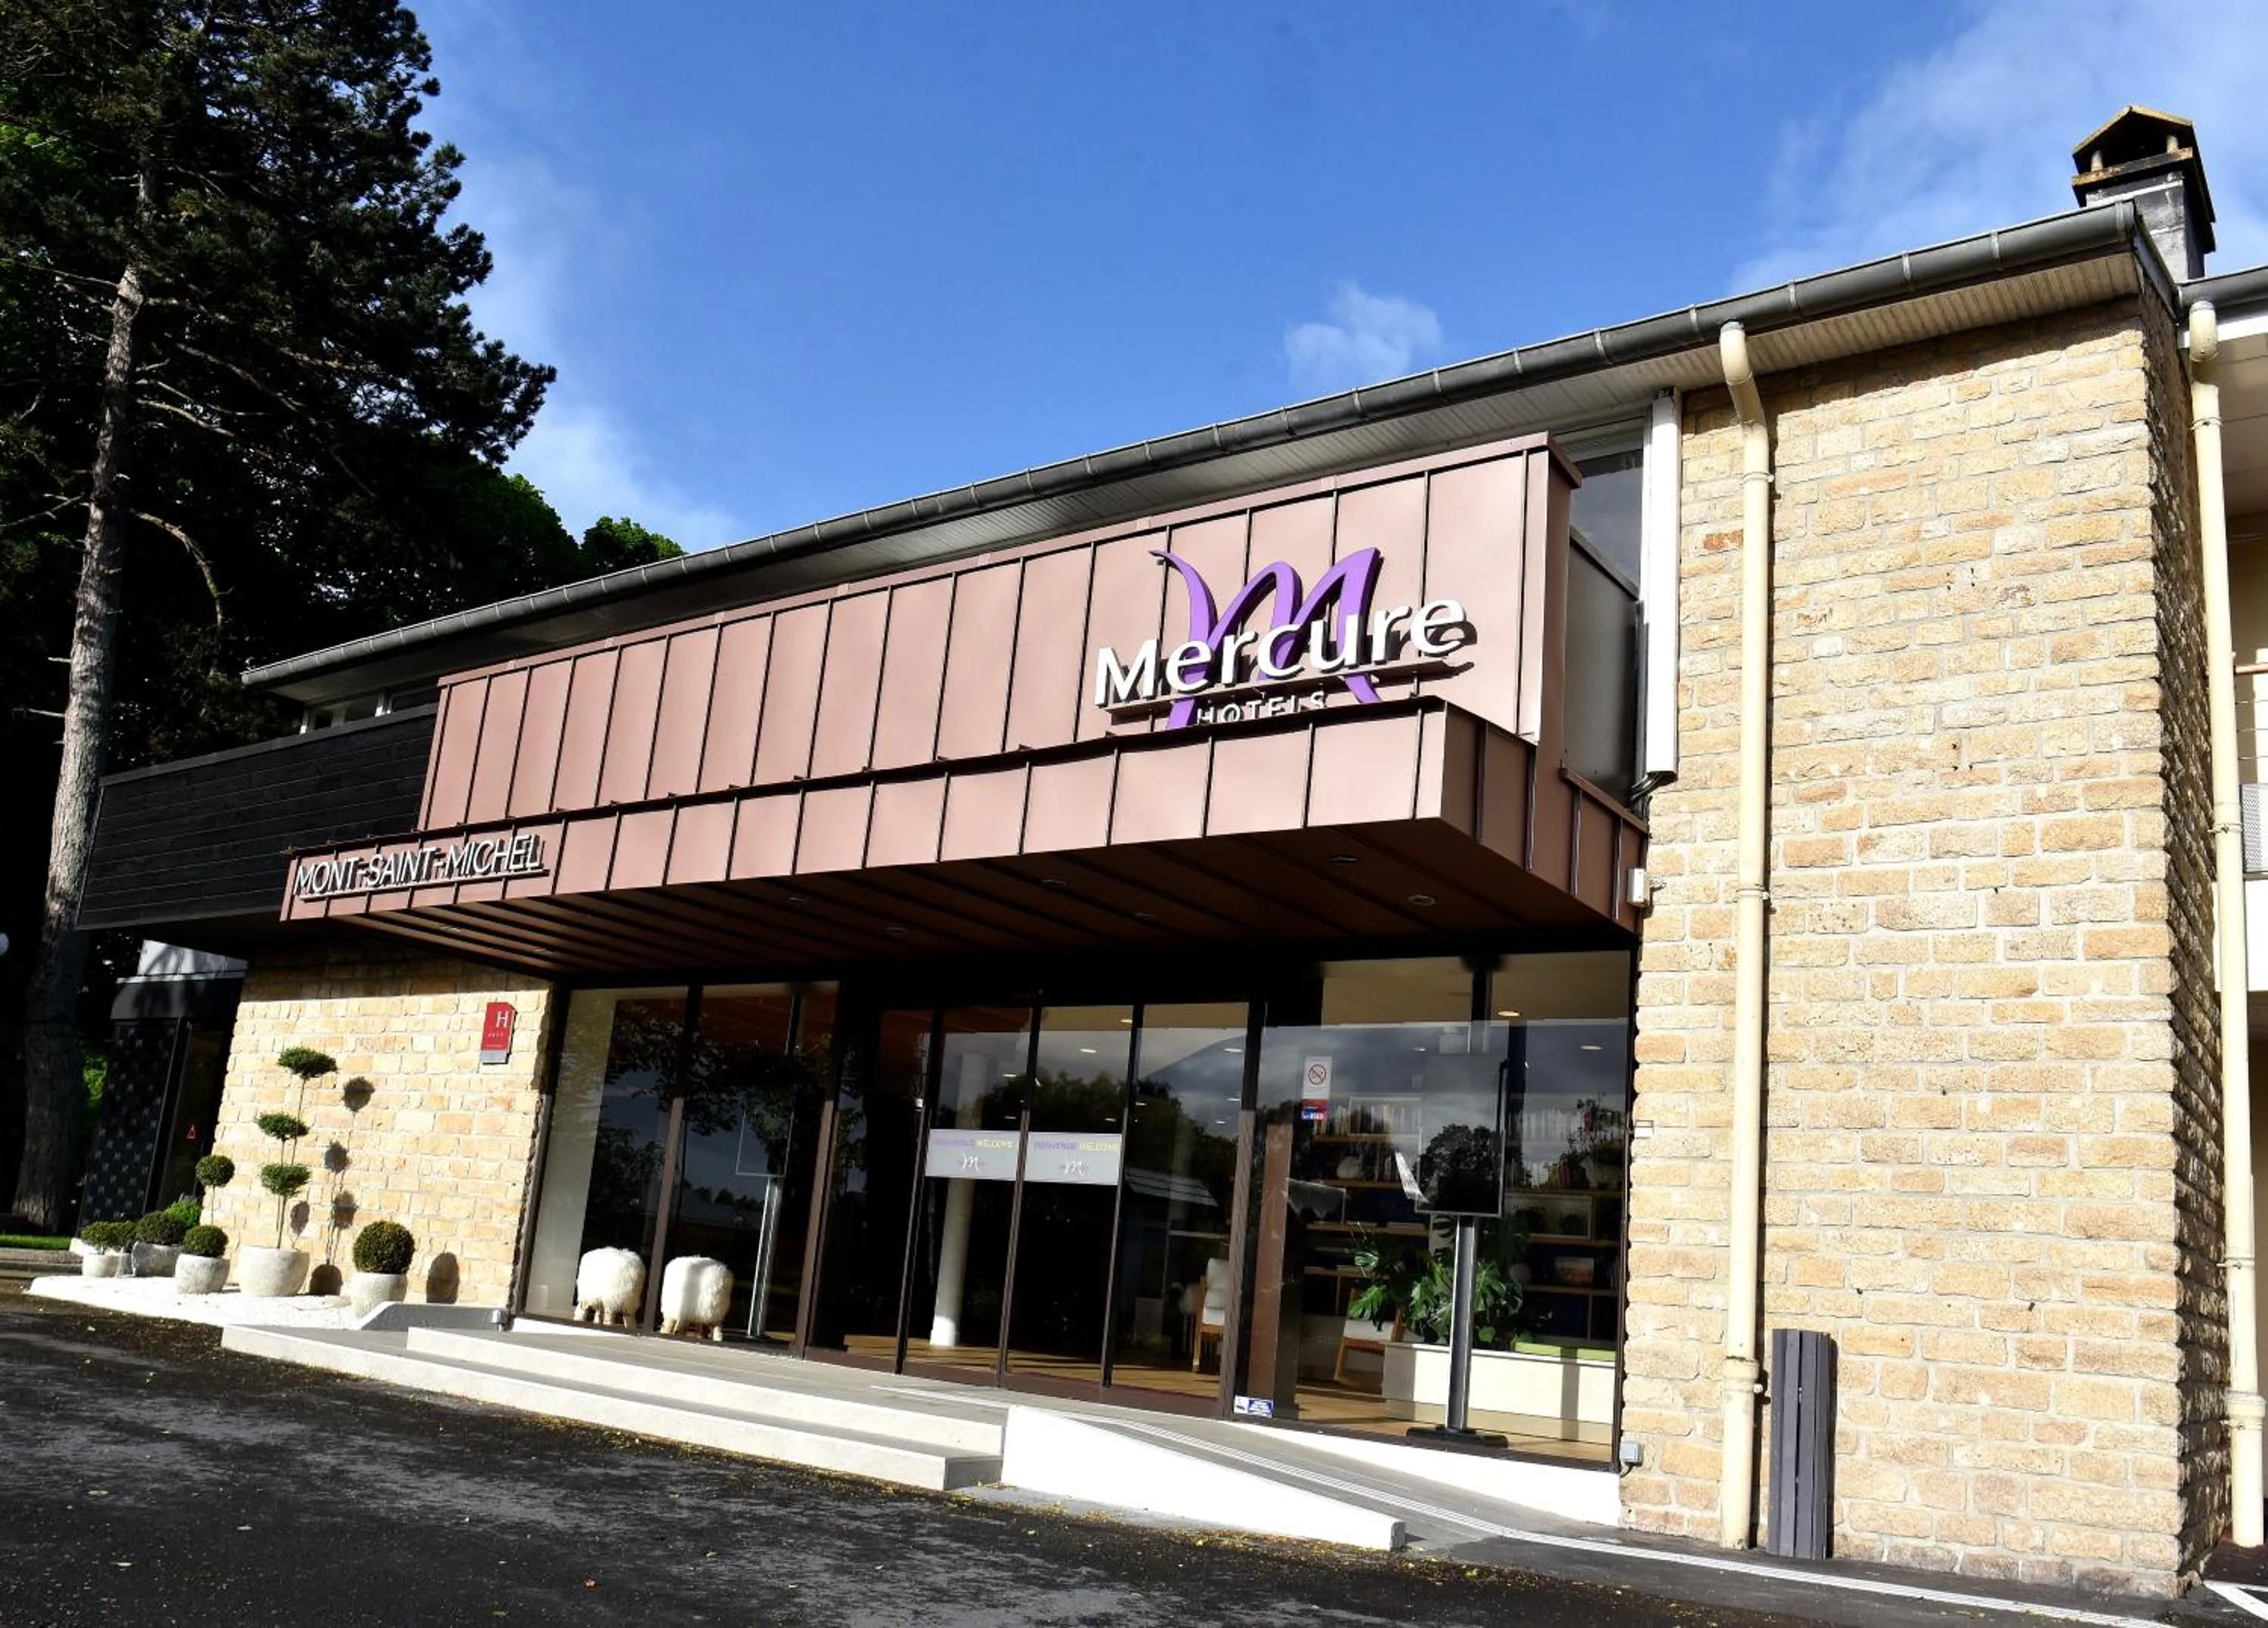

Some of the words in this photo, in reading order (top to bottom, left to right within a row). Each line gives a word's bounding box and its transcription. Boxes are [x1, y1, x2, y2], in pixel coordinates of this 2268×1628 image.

[1094, 599, 1467, 707] Mercure
[1197, 690, 1326, 725] HOTELS
[293, 834, 542, 896] MONT-SAINT-MICHEL
[495, 1011, 509, 1028] H
